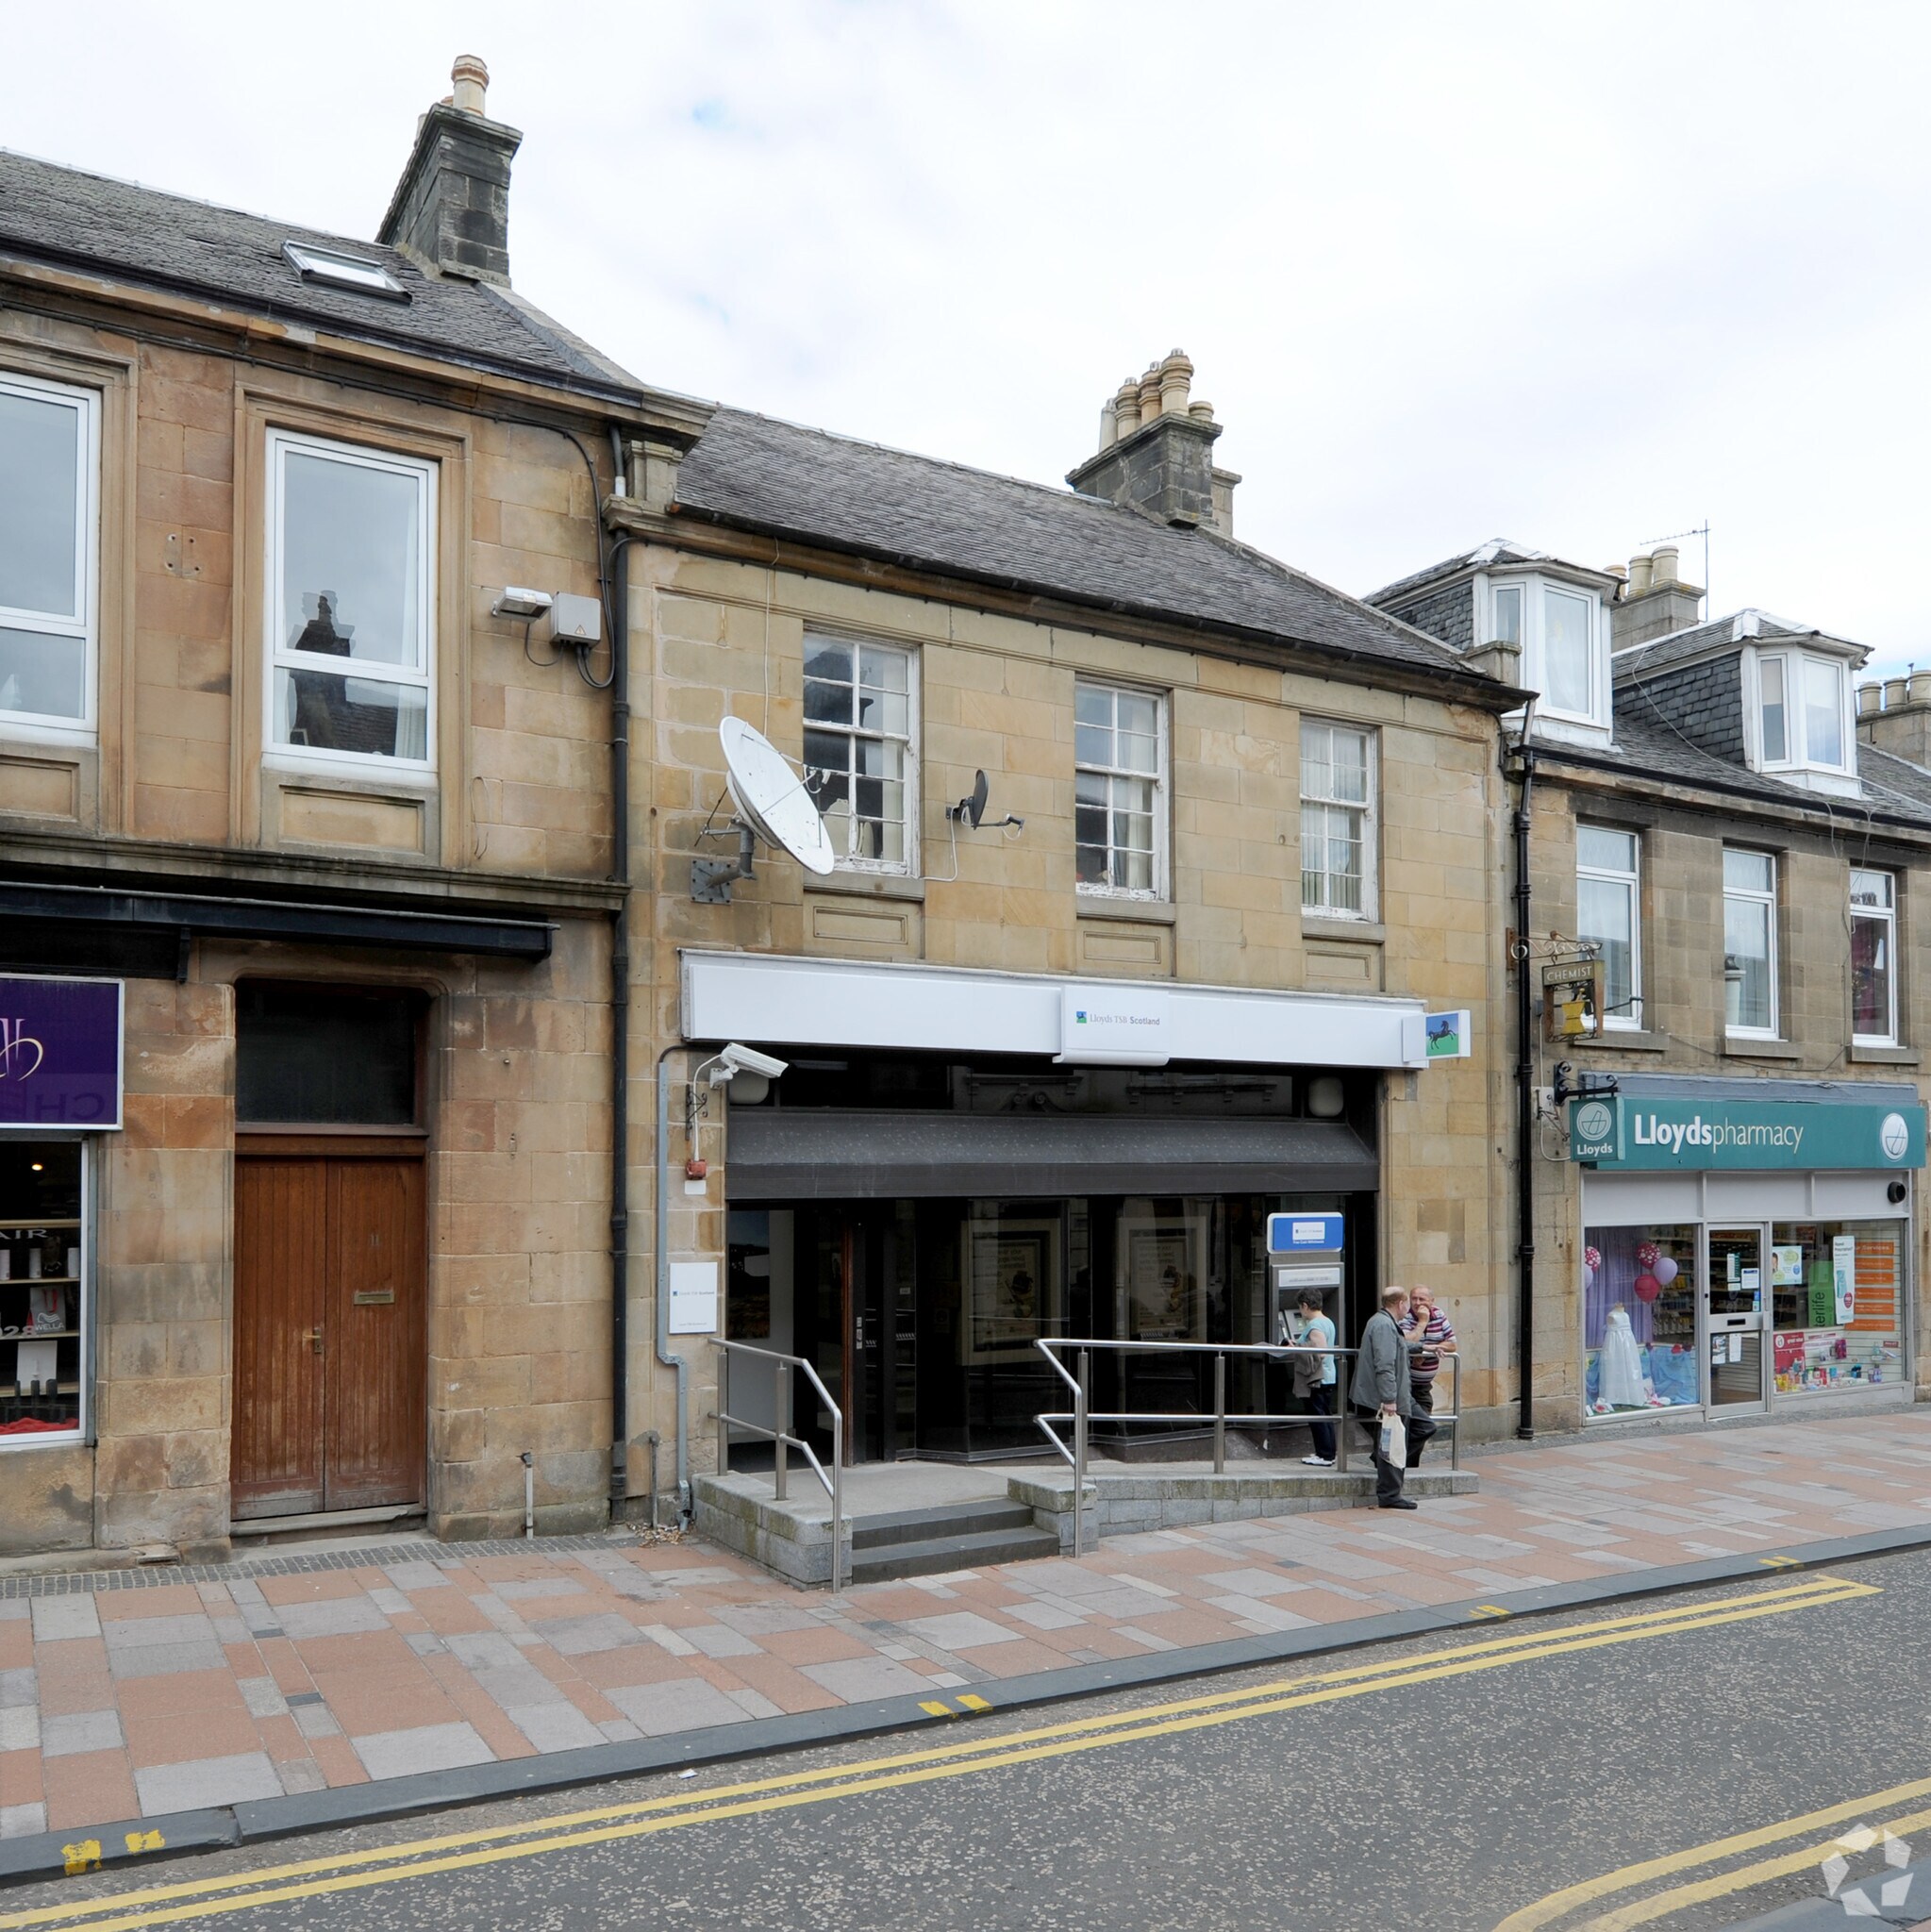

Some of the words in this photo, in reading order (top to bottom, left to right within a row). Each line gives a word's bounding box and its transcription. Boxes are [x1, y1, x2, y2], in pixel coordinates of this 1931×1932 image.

[1546, 965, 1592, 981] CHEMIST
[1090, 1013, 1113, 1024] Lloyds
[1114, 1015, 1128, 1024] TSB
[1129, 1016, 1160, 1025] Scotland
[1635, 1113, 1805, 1155] Lloydspharmacy
[1576, 1142, 1613, 1157] Lloyds
[35, 1322, 65, 1331] WELLA
